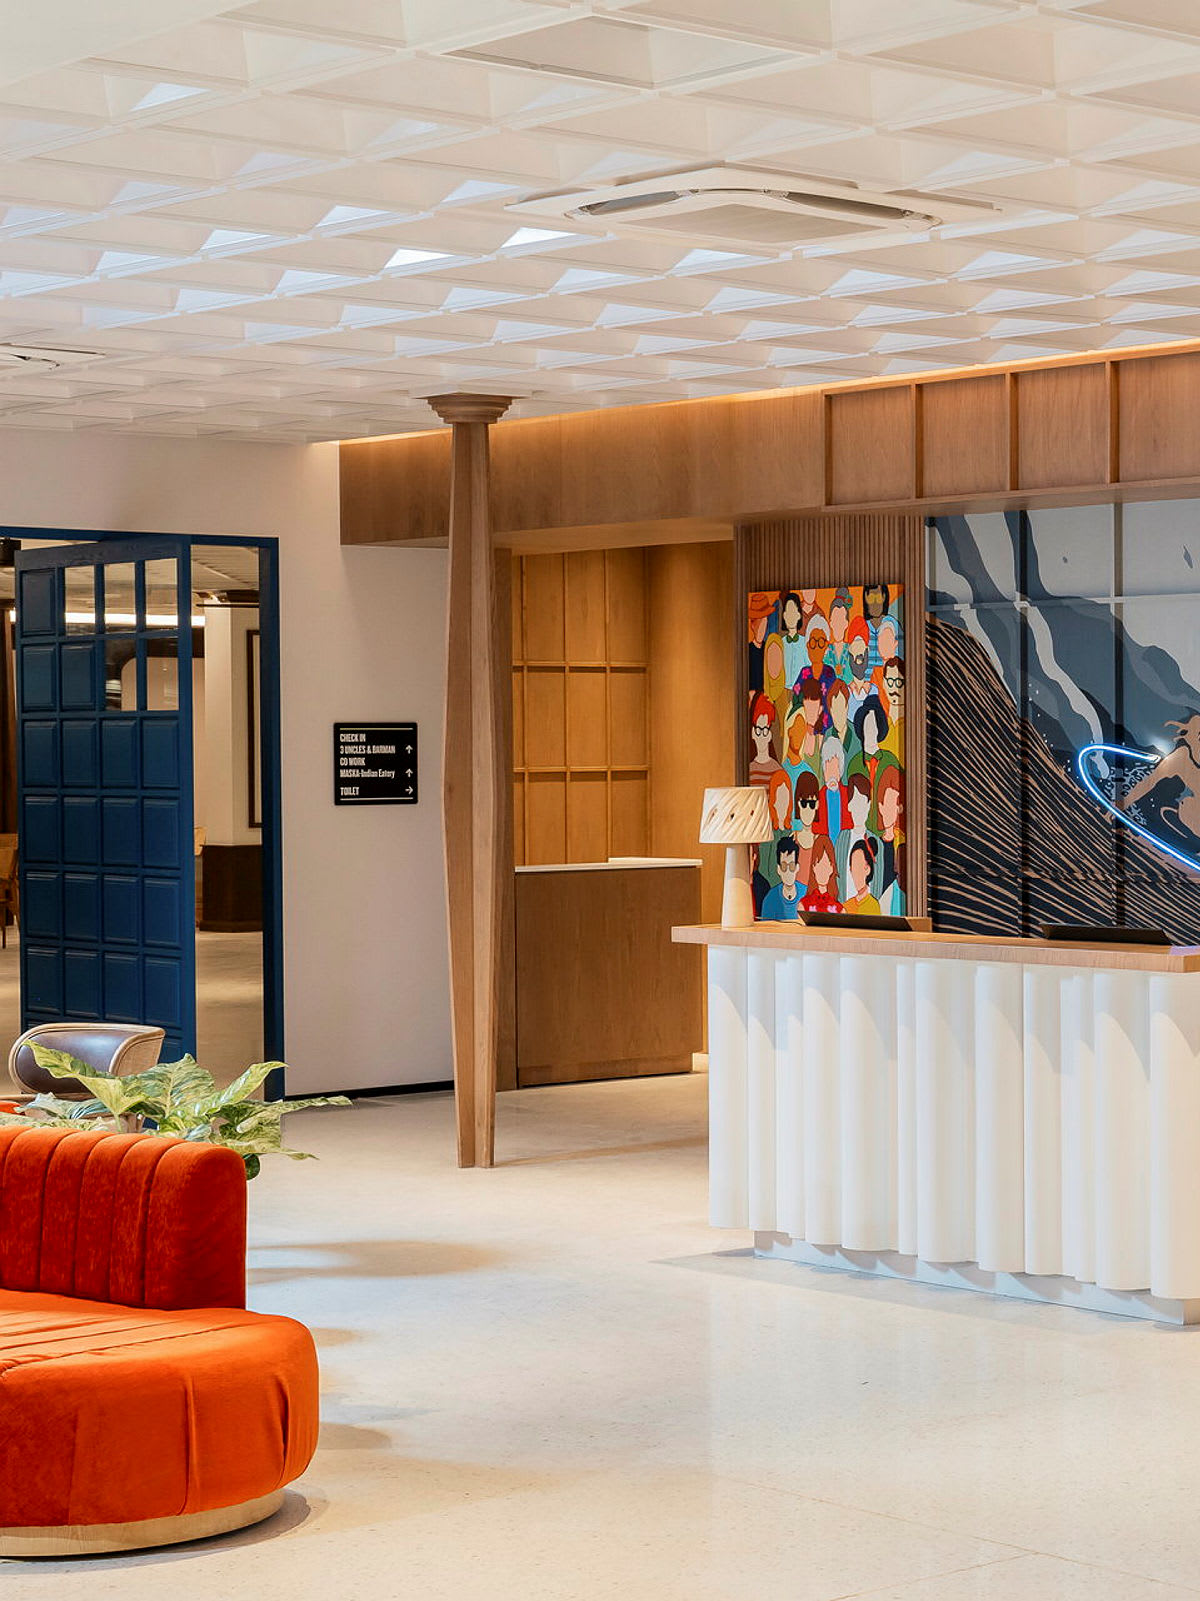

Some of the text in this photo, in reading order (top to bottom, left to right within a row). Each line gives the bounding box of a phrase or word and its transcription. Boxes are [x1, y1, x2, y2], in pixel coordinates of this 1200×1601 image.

[340, 734, 359, 742] CHECK
[340, 745, 344, 754] 3
[367, 745, 372, 754] &
[349, 758, 366, 766] WORK
[378, 769, 396, 779] Eatery
[340, 787, 360, 796] TOILET
